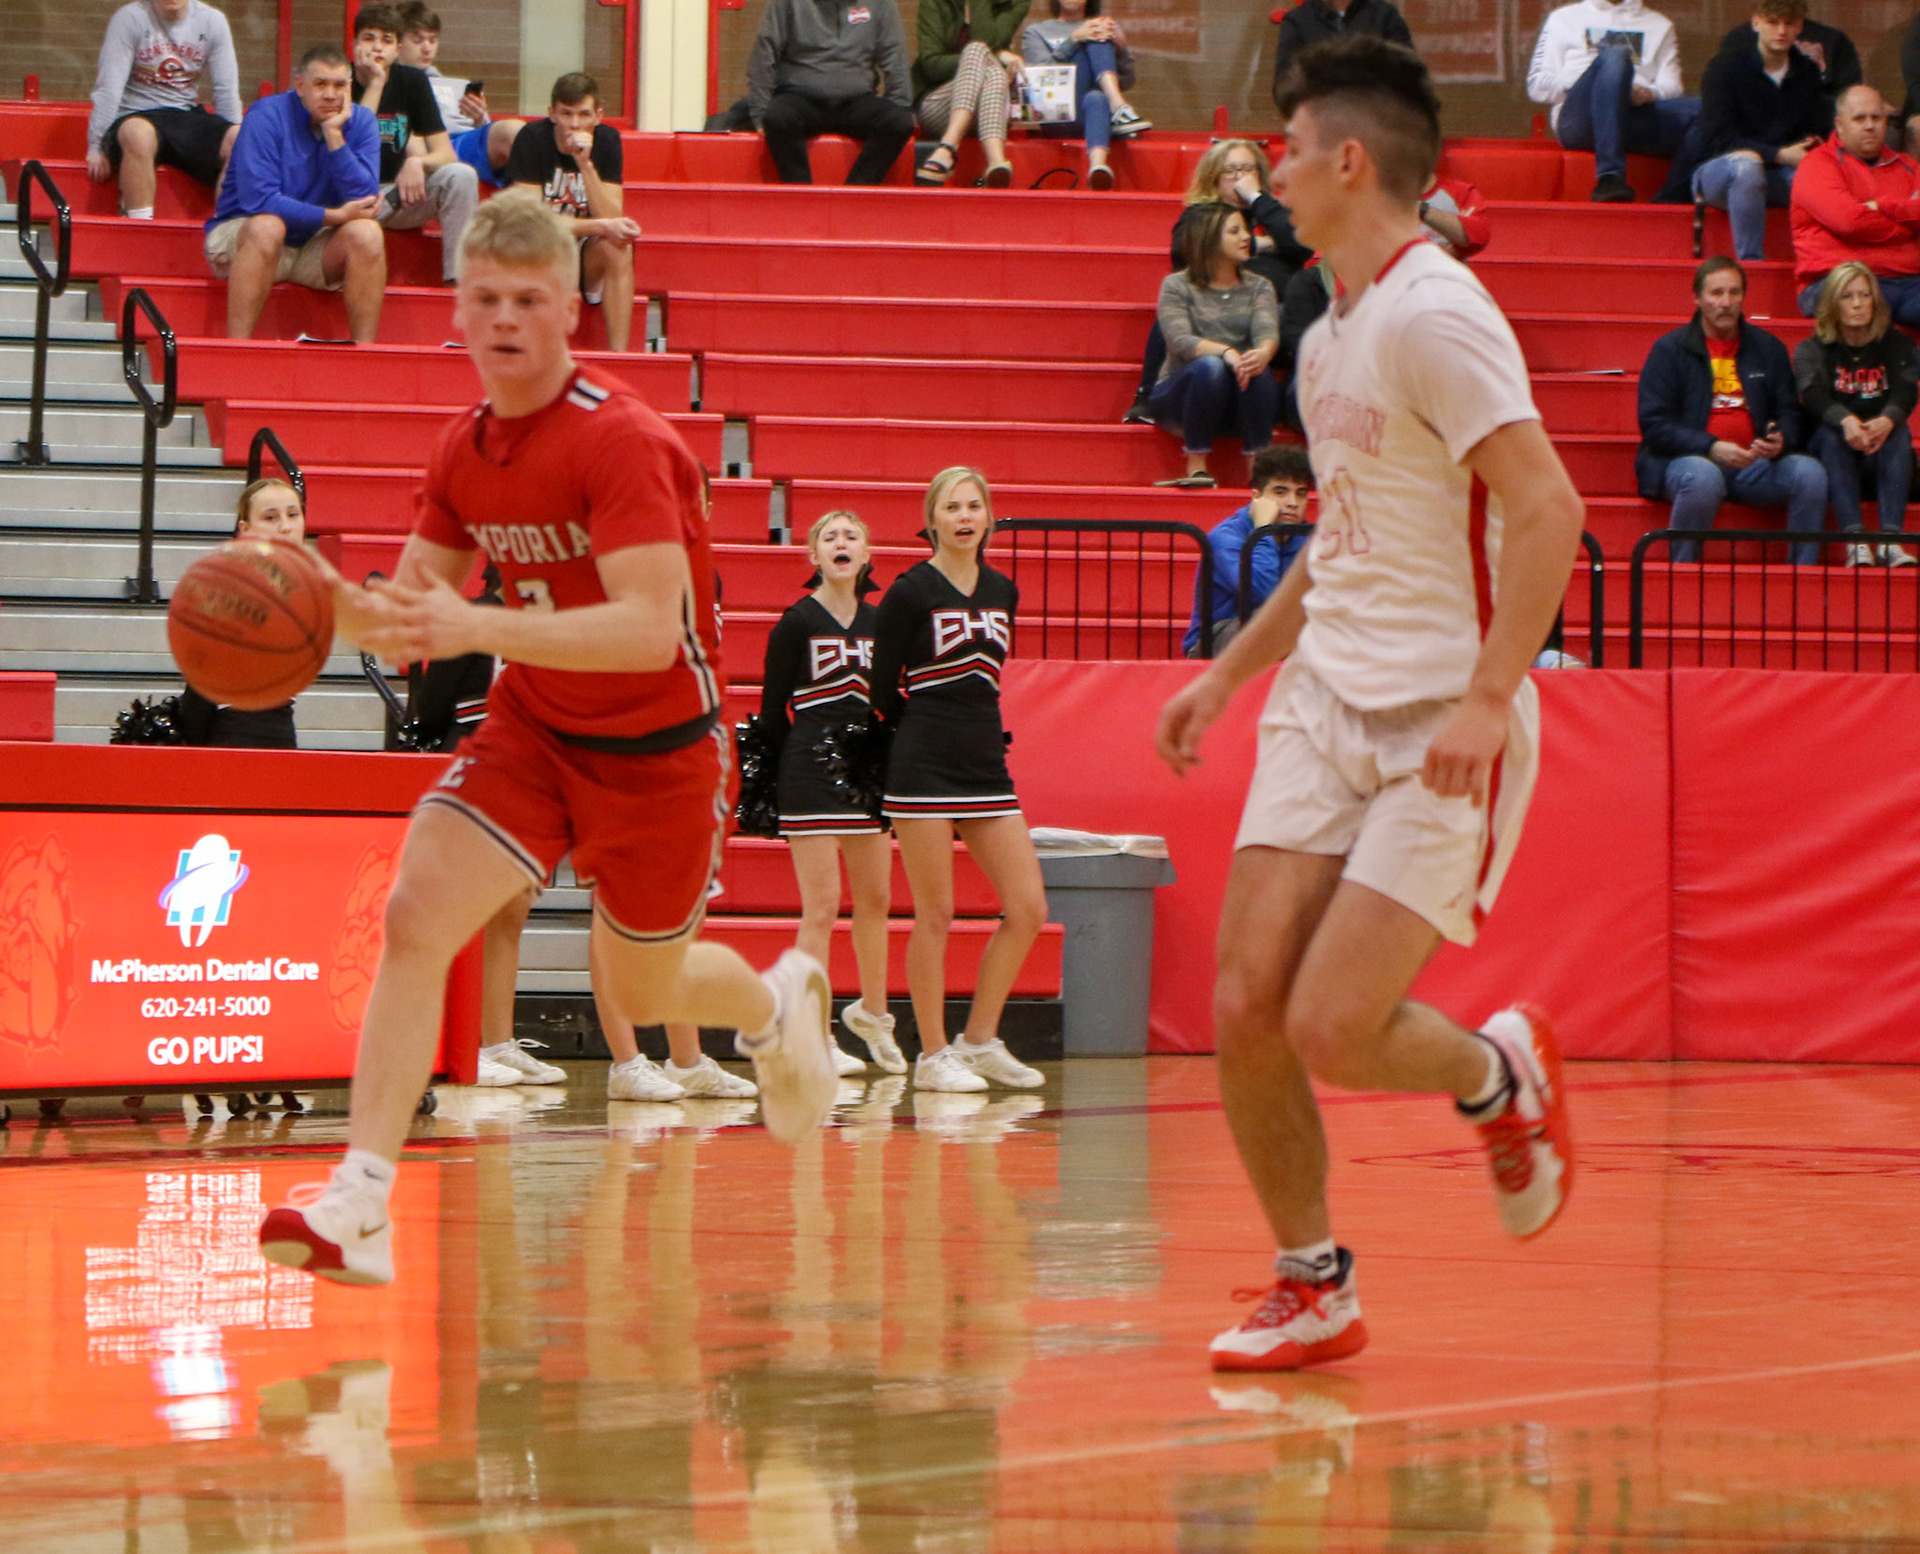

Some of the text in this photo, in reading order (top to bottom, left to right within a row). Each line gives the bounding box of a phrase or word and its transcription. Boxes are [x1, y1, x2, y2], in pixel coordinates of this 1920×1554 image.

[931, 608, 1010, 659] EHS
[91, 957, 319, 983] McPherson Dental Care
[141, 996, 270, 1018] 620-241-5000
[147, 1035, 263, 1065] GO PUPS!
